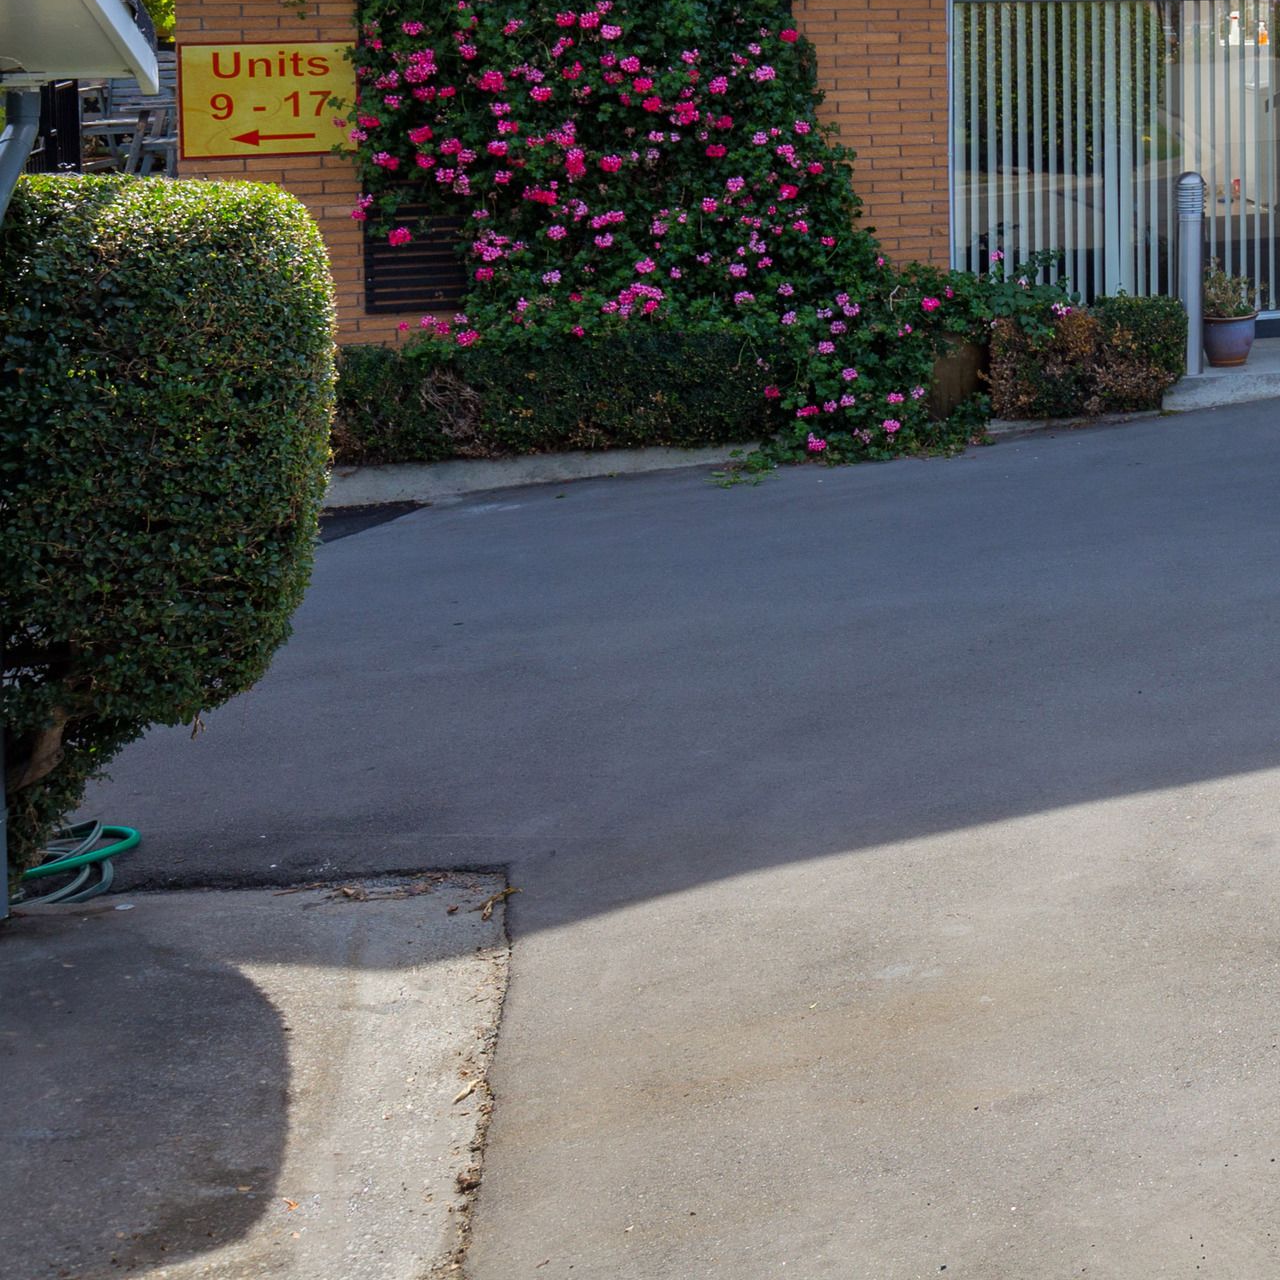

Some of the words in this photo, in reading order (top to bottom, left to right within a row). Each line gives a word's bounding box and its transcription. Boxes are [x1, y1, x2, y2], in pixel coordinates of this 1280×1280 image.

[211, 51, 331, 79] Units
[209, 93, 235, 120] 9
[283, 90, 333, 118] 17
